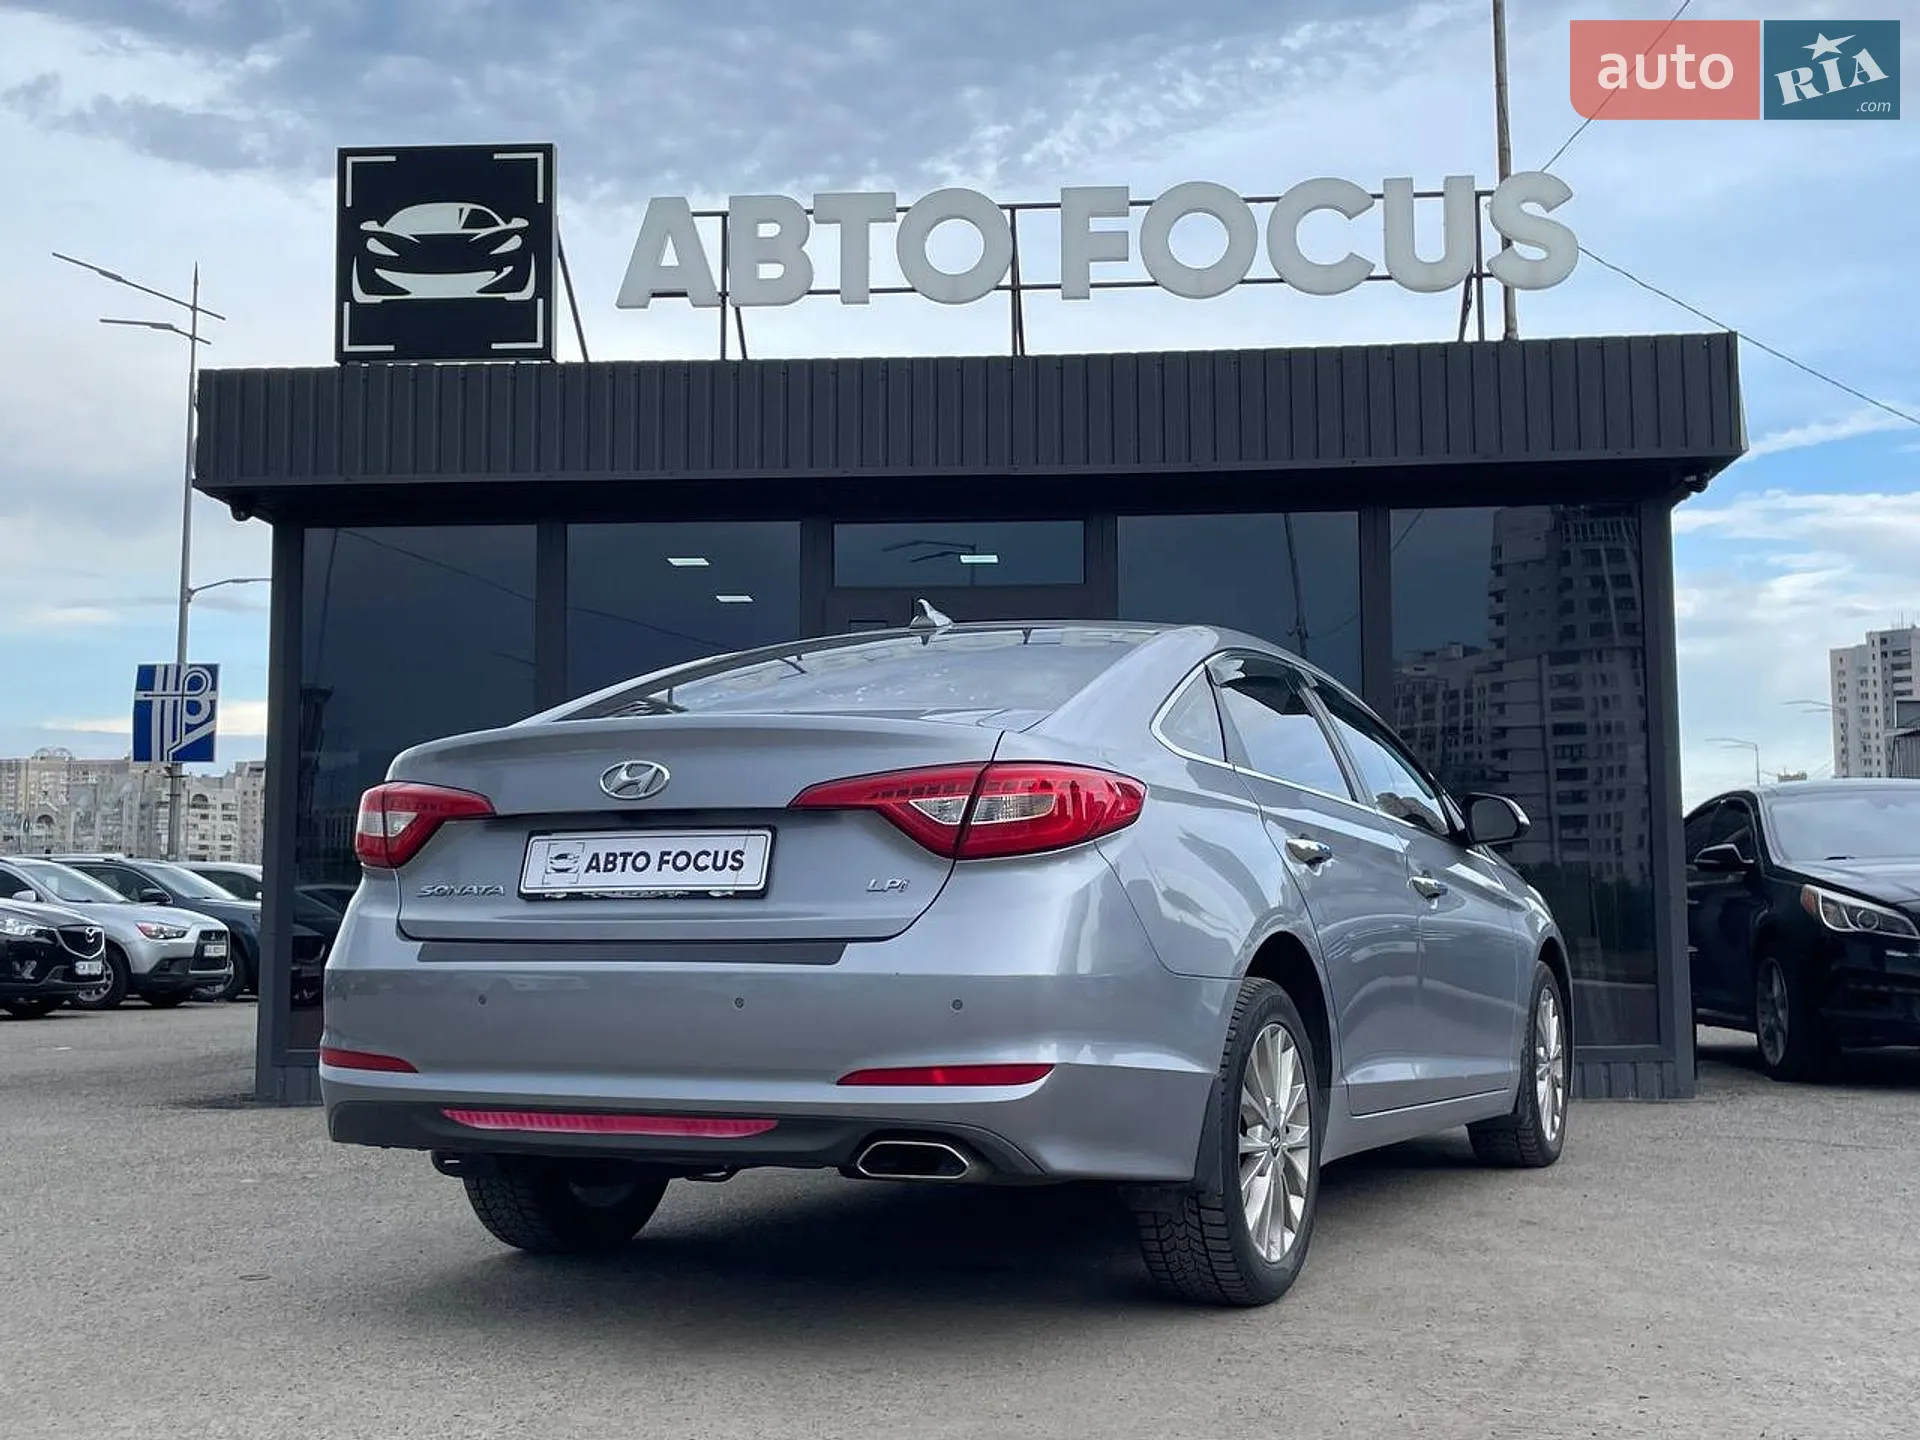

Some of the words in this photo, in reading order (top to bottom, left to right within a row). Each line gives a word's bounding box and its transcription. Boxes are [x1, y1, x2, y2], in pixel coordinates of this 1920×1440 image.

[616, 188, 1013, 308] АВТО
[1060, 171, 1578, 301] FOCUS
[585, 850, 651, 873] АВТО
[657, 849, 745, 873] FOCUS
[416, 884, 505, 898] SONATA
